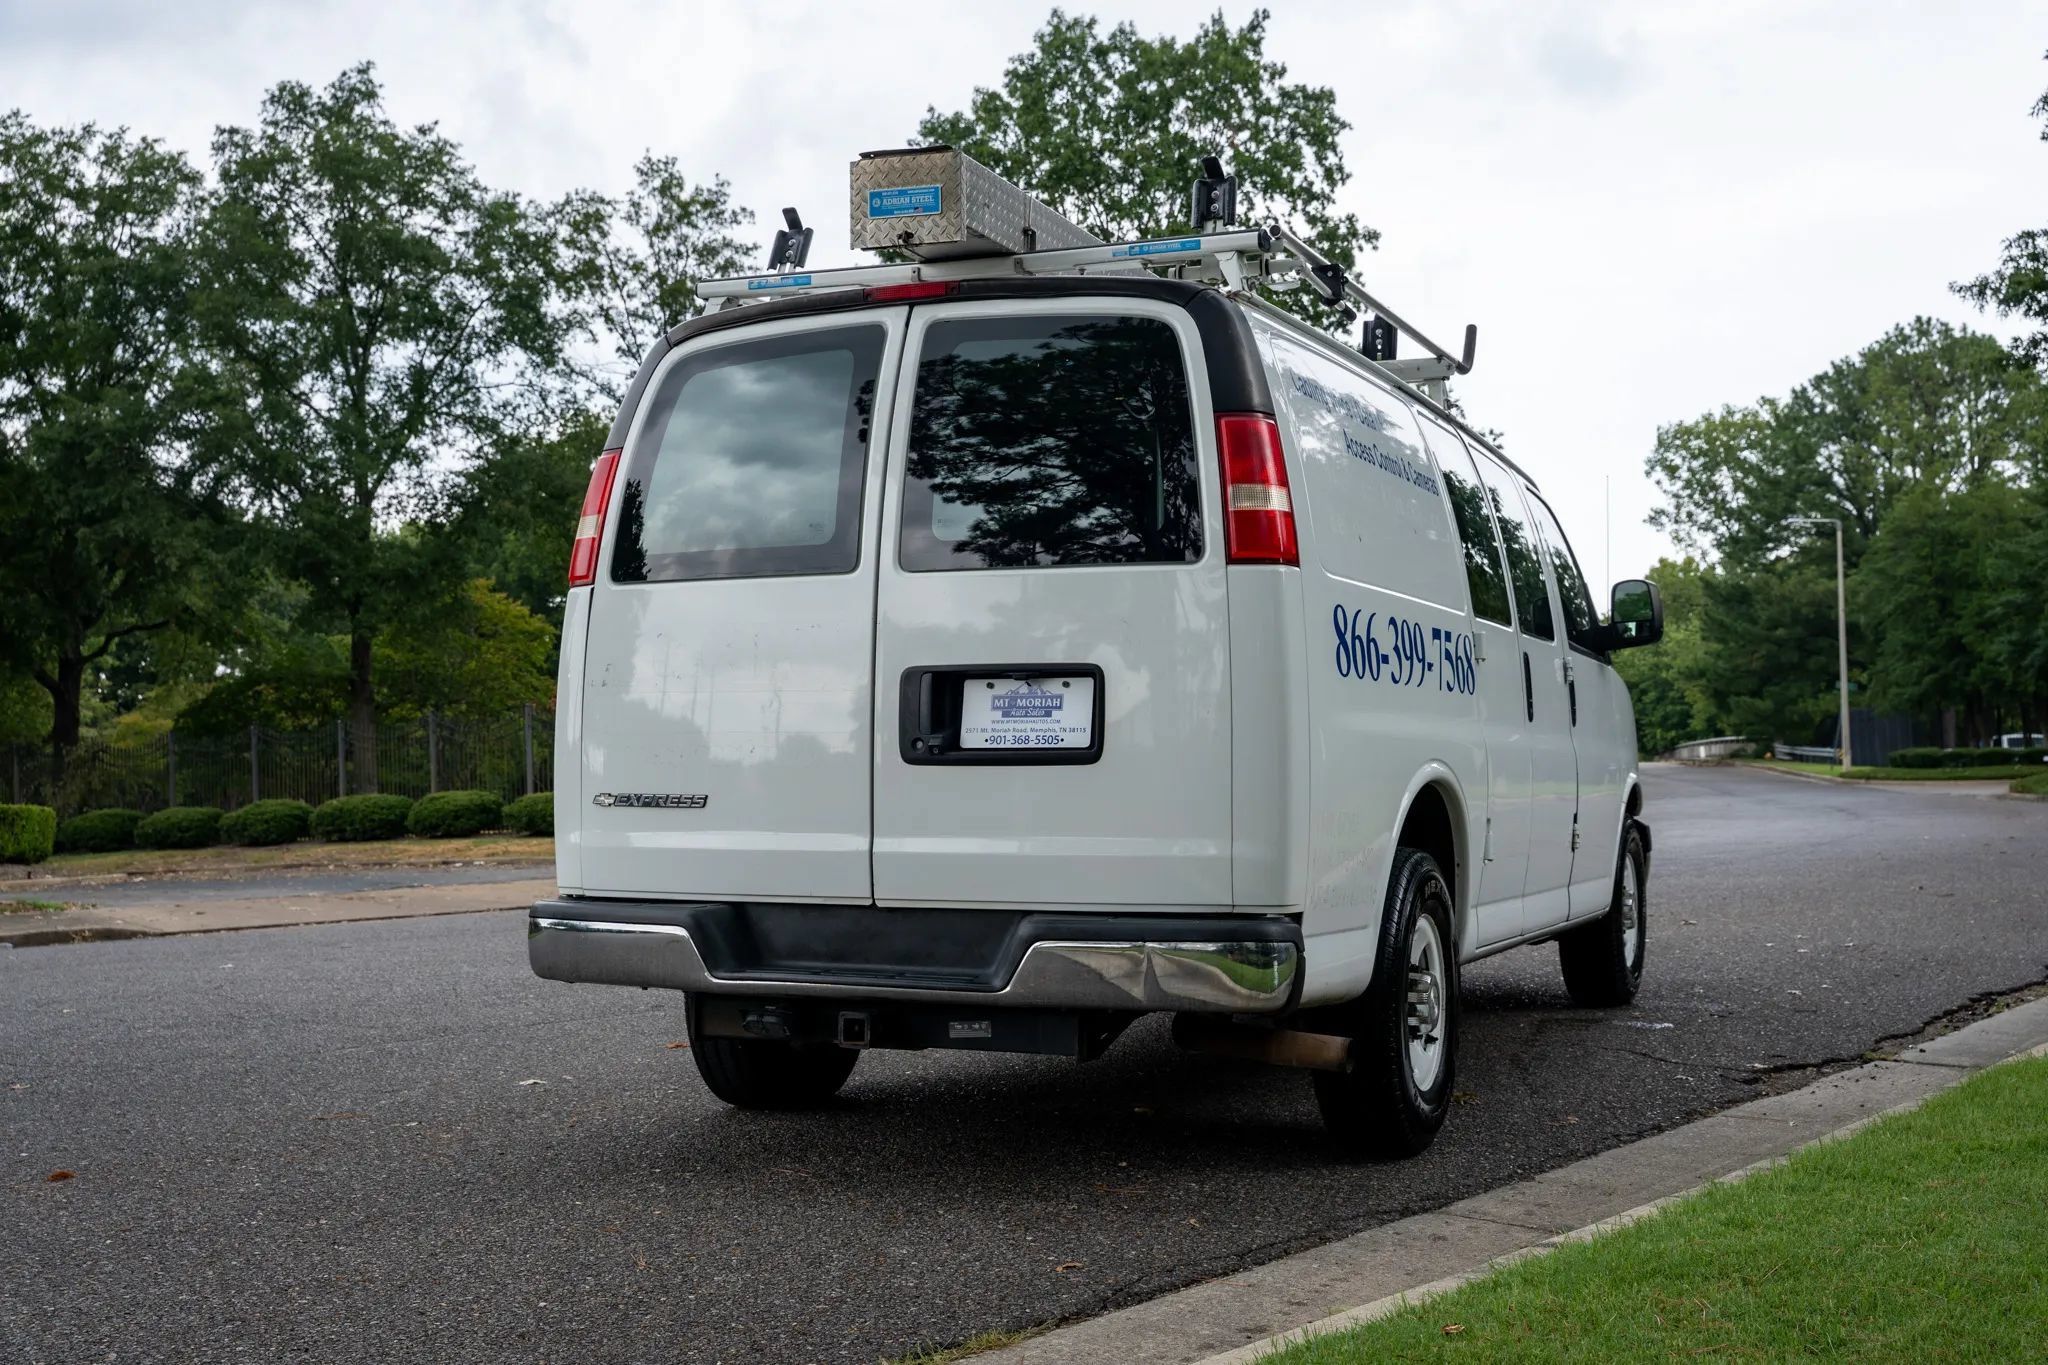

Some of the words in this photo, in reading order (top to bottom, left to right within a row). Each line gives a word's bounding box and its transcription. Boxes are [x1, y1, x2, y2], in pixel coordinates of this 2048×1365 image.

[882, 196, 910, 206] ADRIAN
[911, 195, 934, 204] STEEL
[1343, 428, 1375, 467] Access
[1373, 443, 1404, 479] Control
[1408, 461, 1439, 497] Cameras
[1333, 604, 1475, 695] 866-399-7568
[994, 698, 1010, 707] MT
[1016, 698, 1061, 707] MORIAH
[615, 793, 707, 808] EXPRESS
